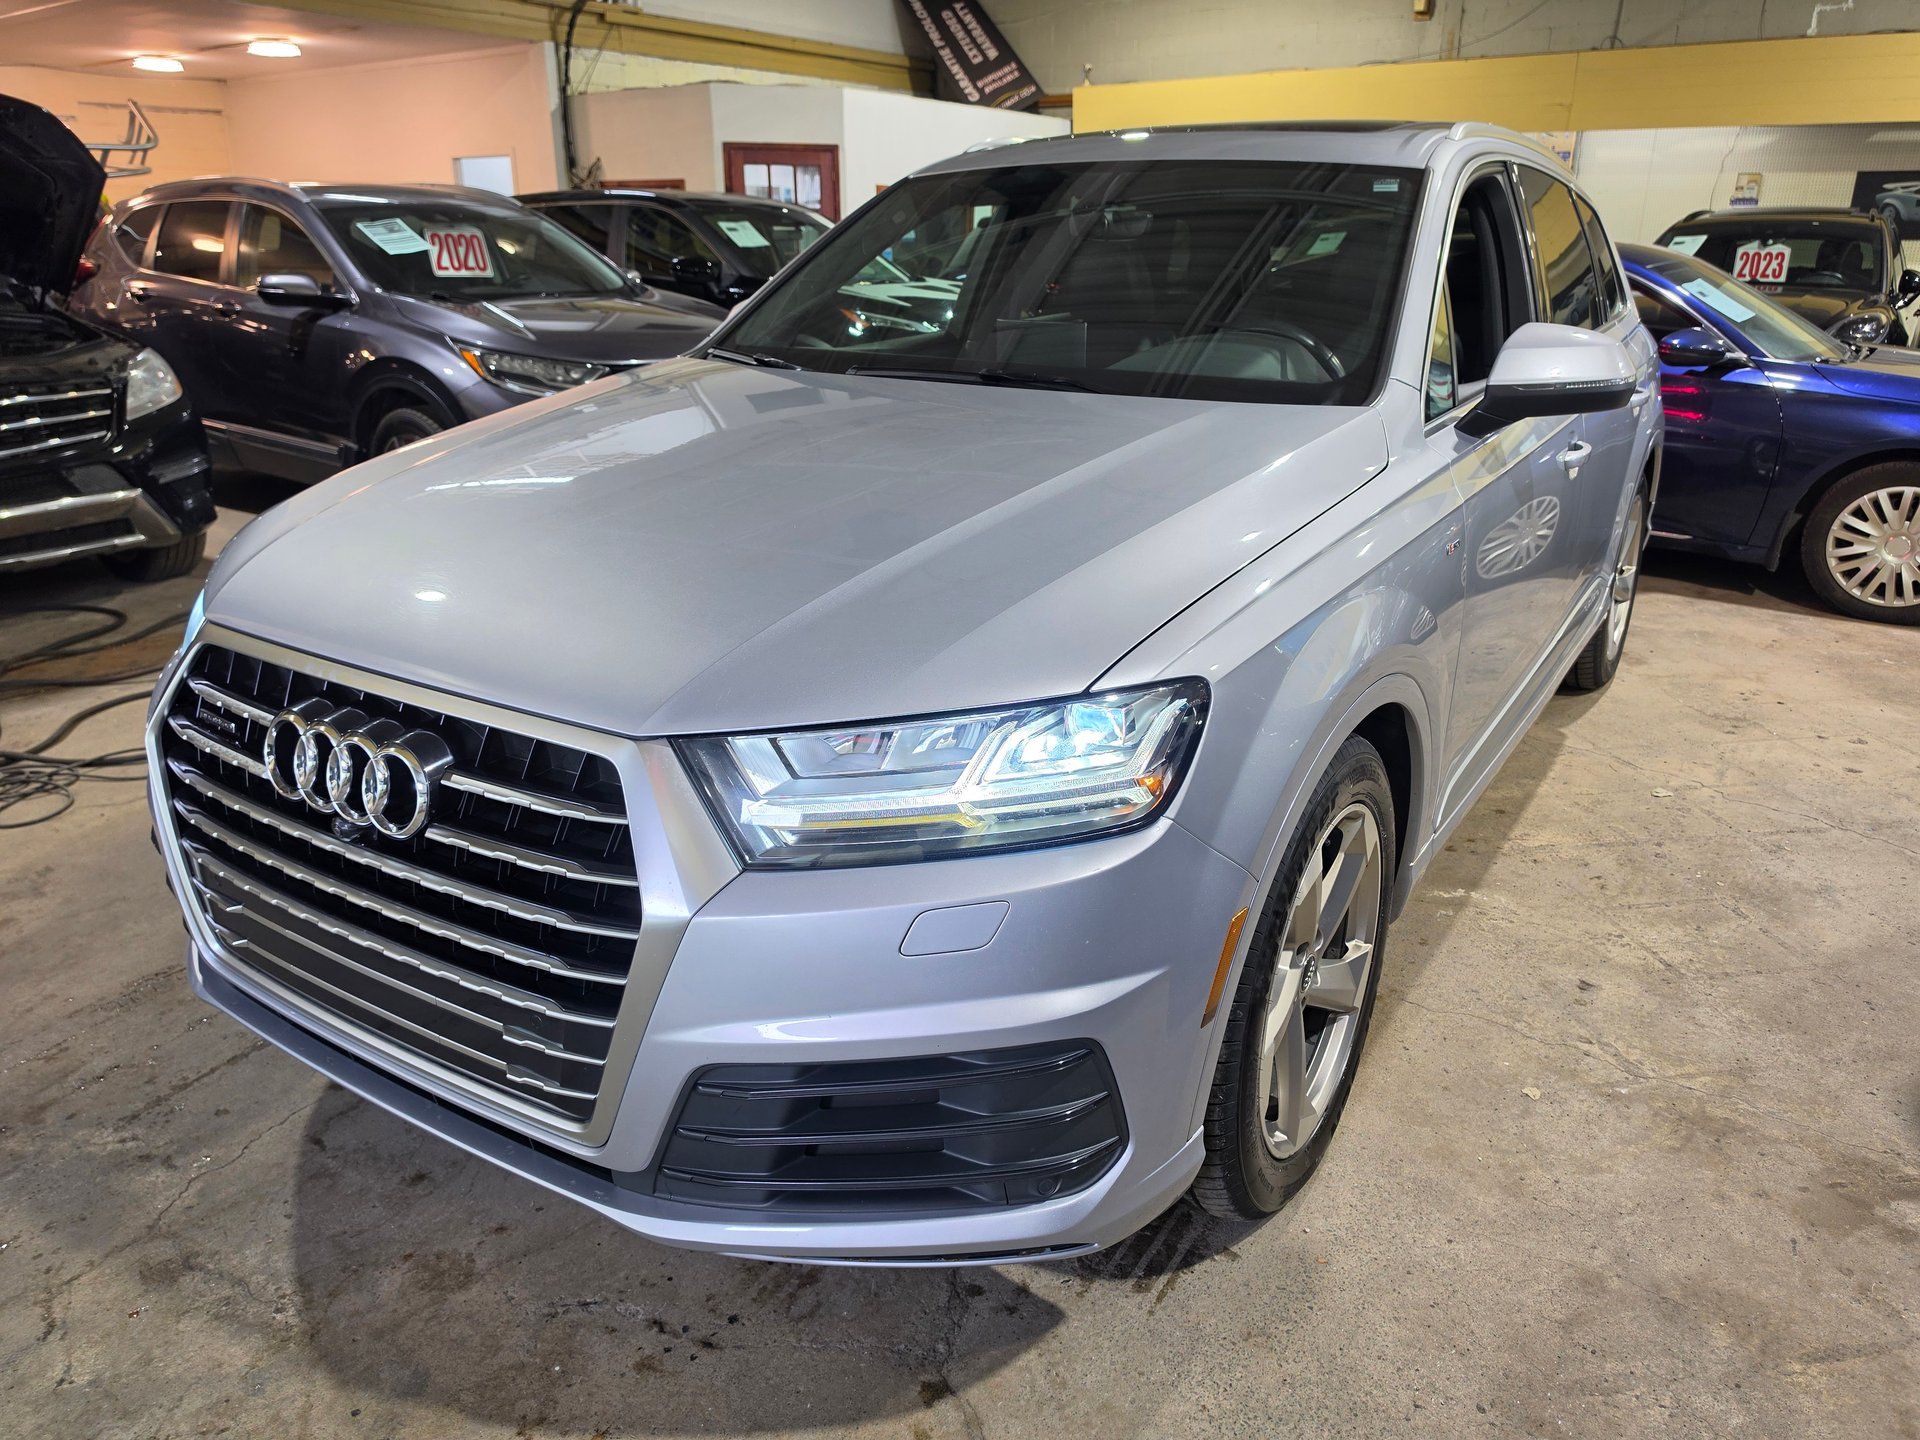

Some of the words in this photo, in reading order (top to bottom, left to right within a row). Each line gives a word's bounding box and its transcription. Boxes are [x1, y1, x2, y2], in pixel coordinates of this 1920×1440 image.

[909, 0, 946, 48] PROLON
[941, 9, 984, 65] EXTENDED
[952, 2, 999, 61] WARRANTY
[938, 47, 981, 102] GARANTIE
[430, 232, 487, 272] 2020
[1736, 251, 1786, 279] 2023
